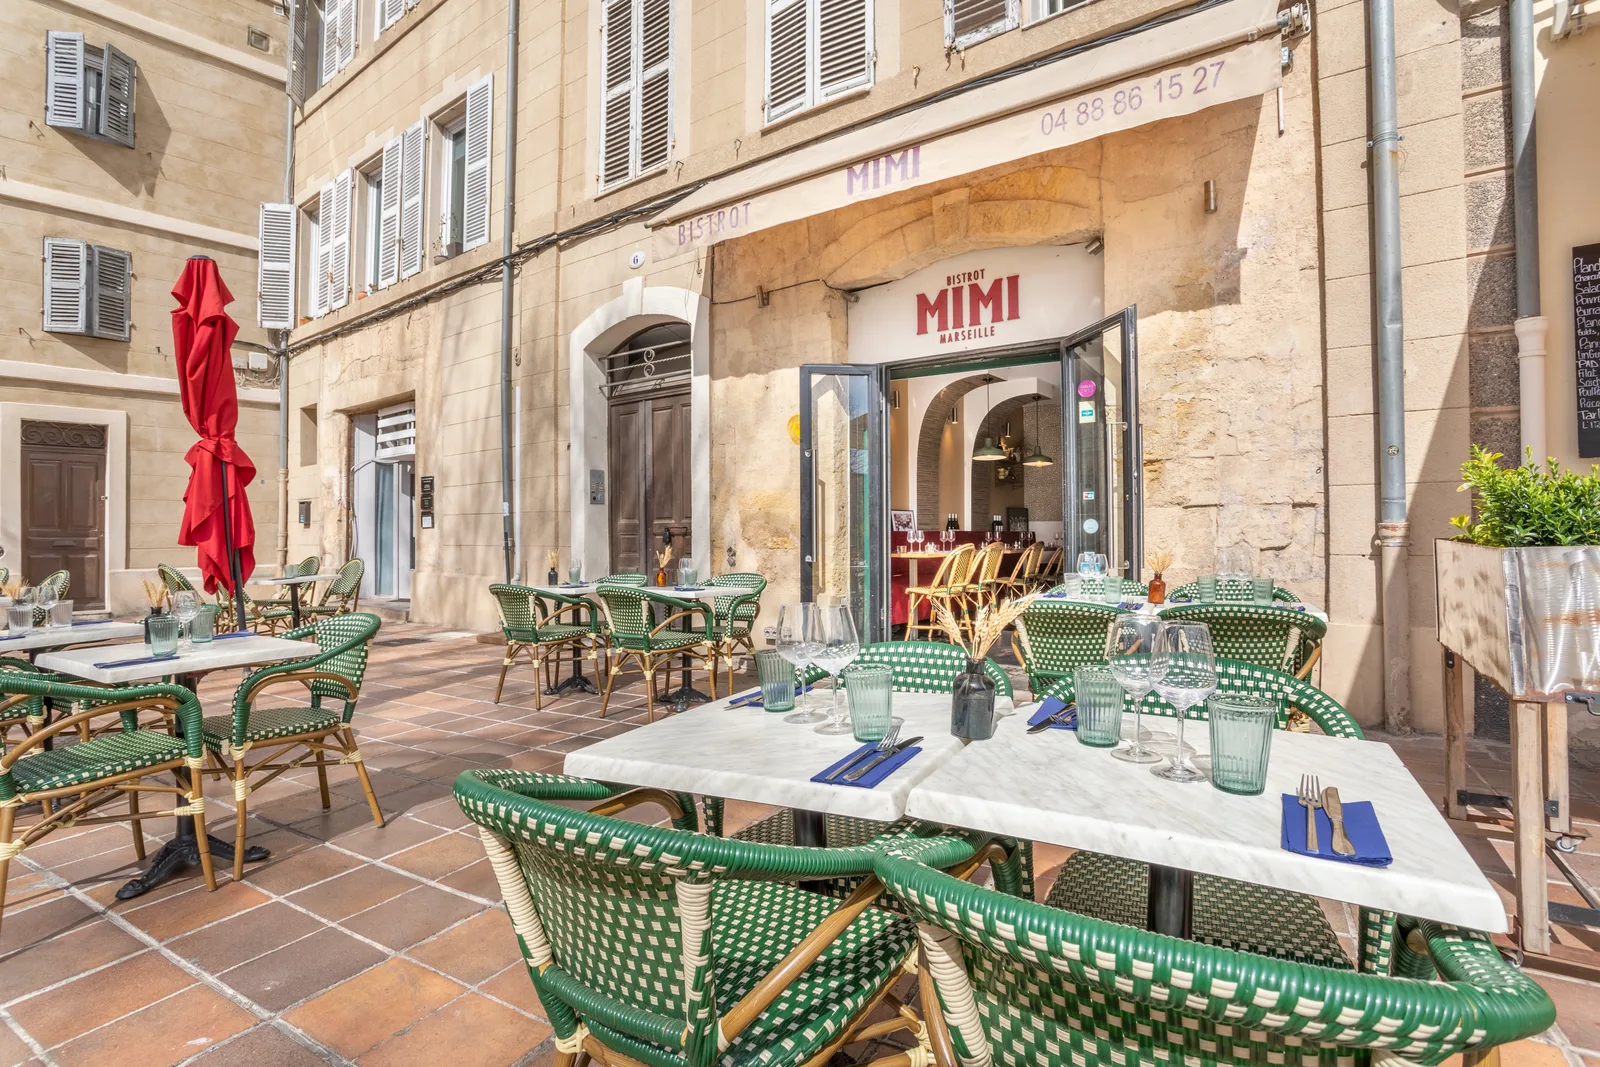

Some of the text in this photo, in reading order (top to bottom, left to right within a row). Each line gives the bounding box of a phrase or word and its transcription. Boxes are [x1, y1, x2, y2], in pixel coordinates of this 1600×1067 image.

[1041, 60, 1225, 136] 04 88 86 15 27
[846, 147, 920, 196] MIMI
[677, 202, 751, 247] BISTROT
[632, 255, 639, 265] 6
[946, 268, 985, 286] BISTROT
[916, 274, 1020, 336] MIMI
[939, 326, 995, 344] MARSEILLE
